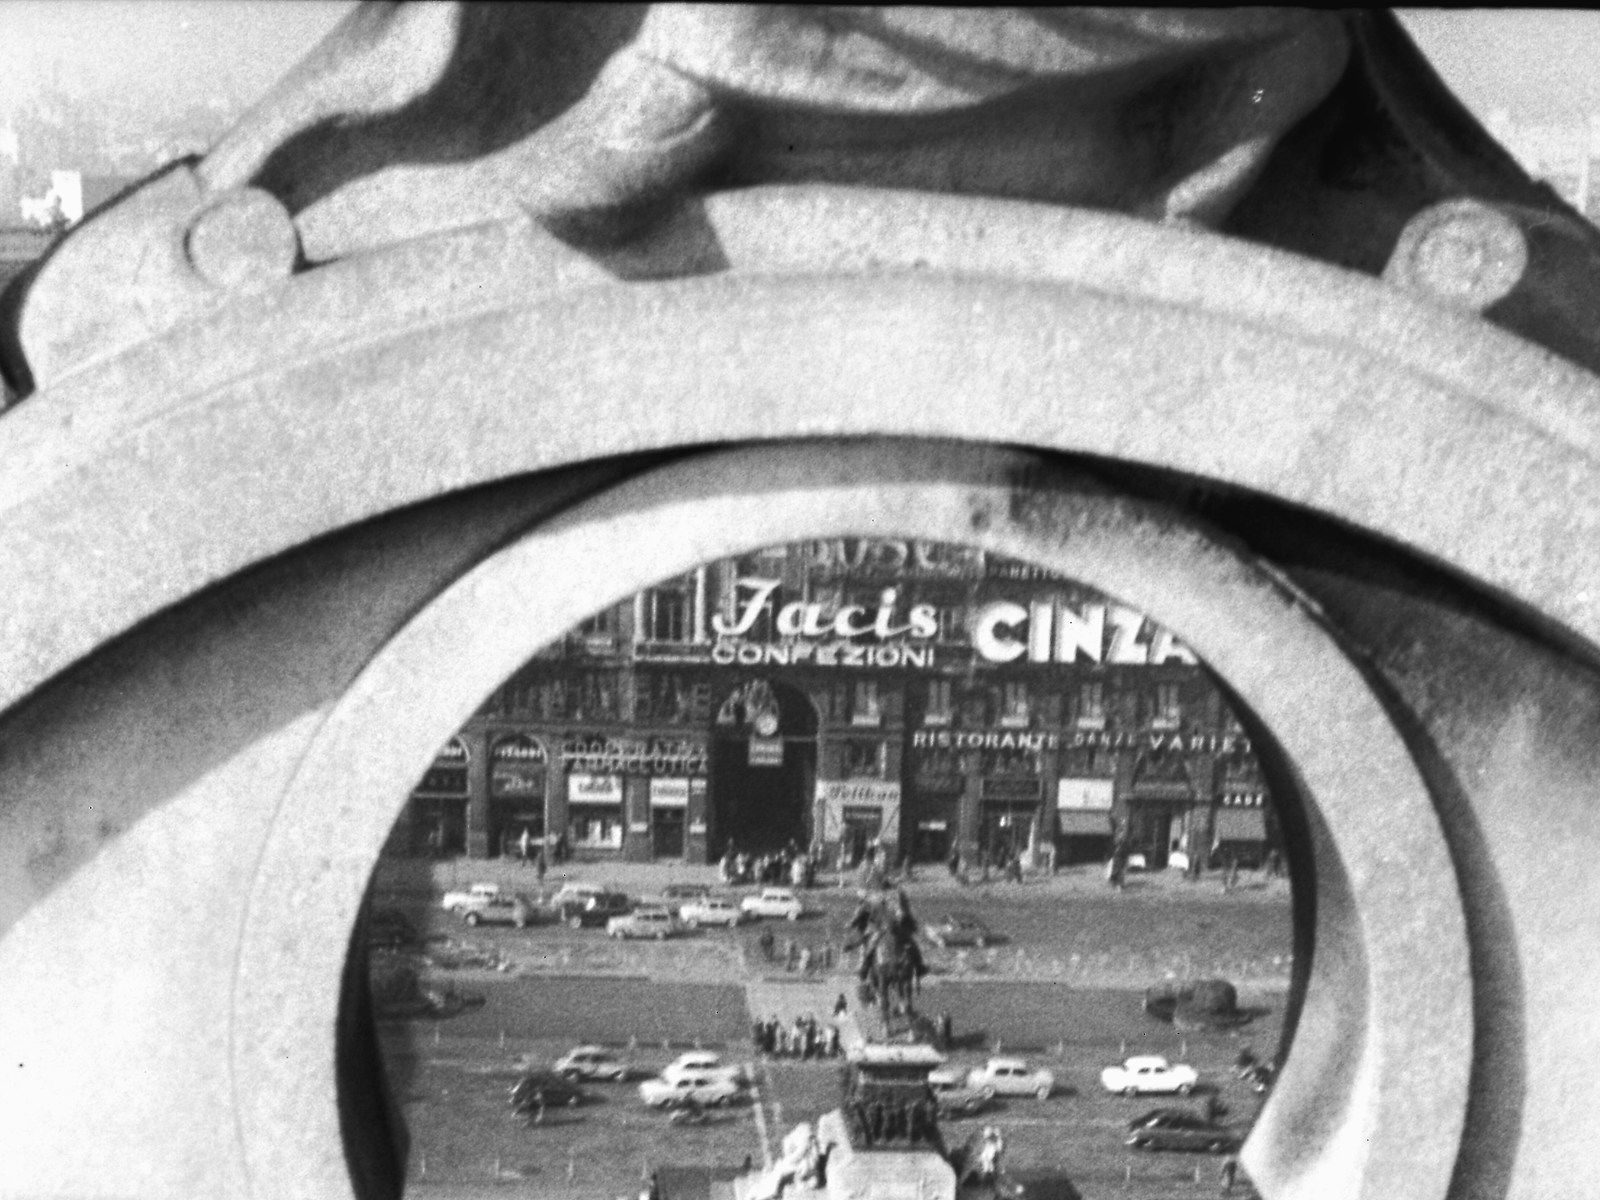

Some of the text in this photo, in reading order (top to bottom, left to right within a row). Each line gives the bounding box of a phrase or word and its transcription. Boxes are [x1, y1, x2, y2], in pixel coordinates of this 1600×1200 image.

[977, 598, 1199, 665] CINZA
[711, 642, 935, 668] CONFEZIONI
[913, 731, 1059, 749] RISTORANTE
